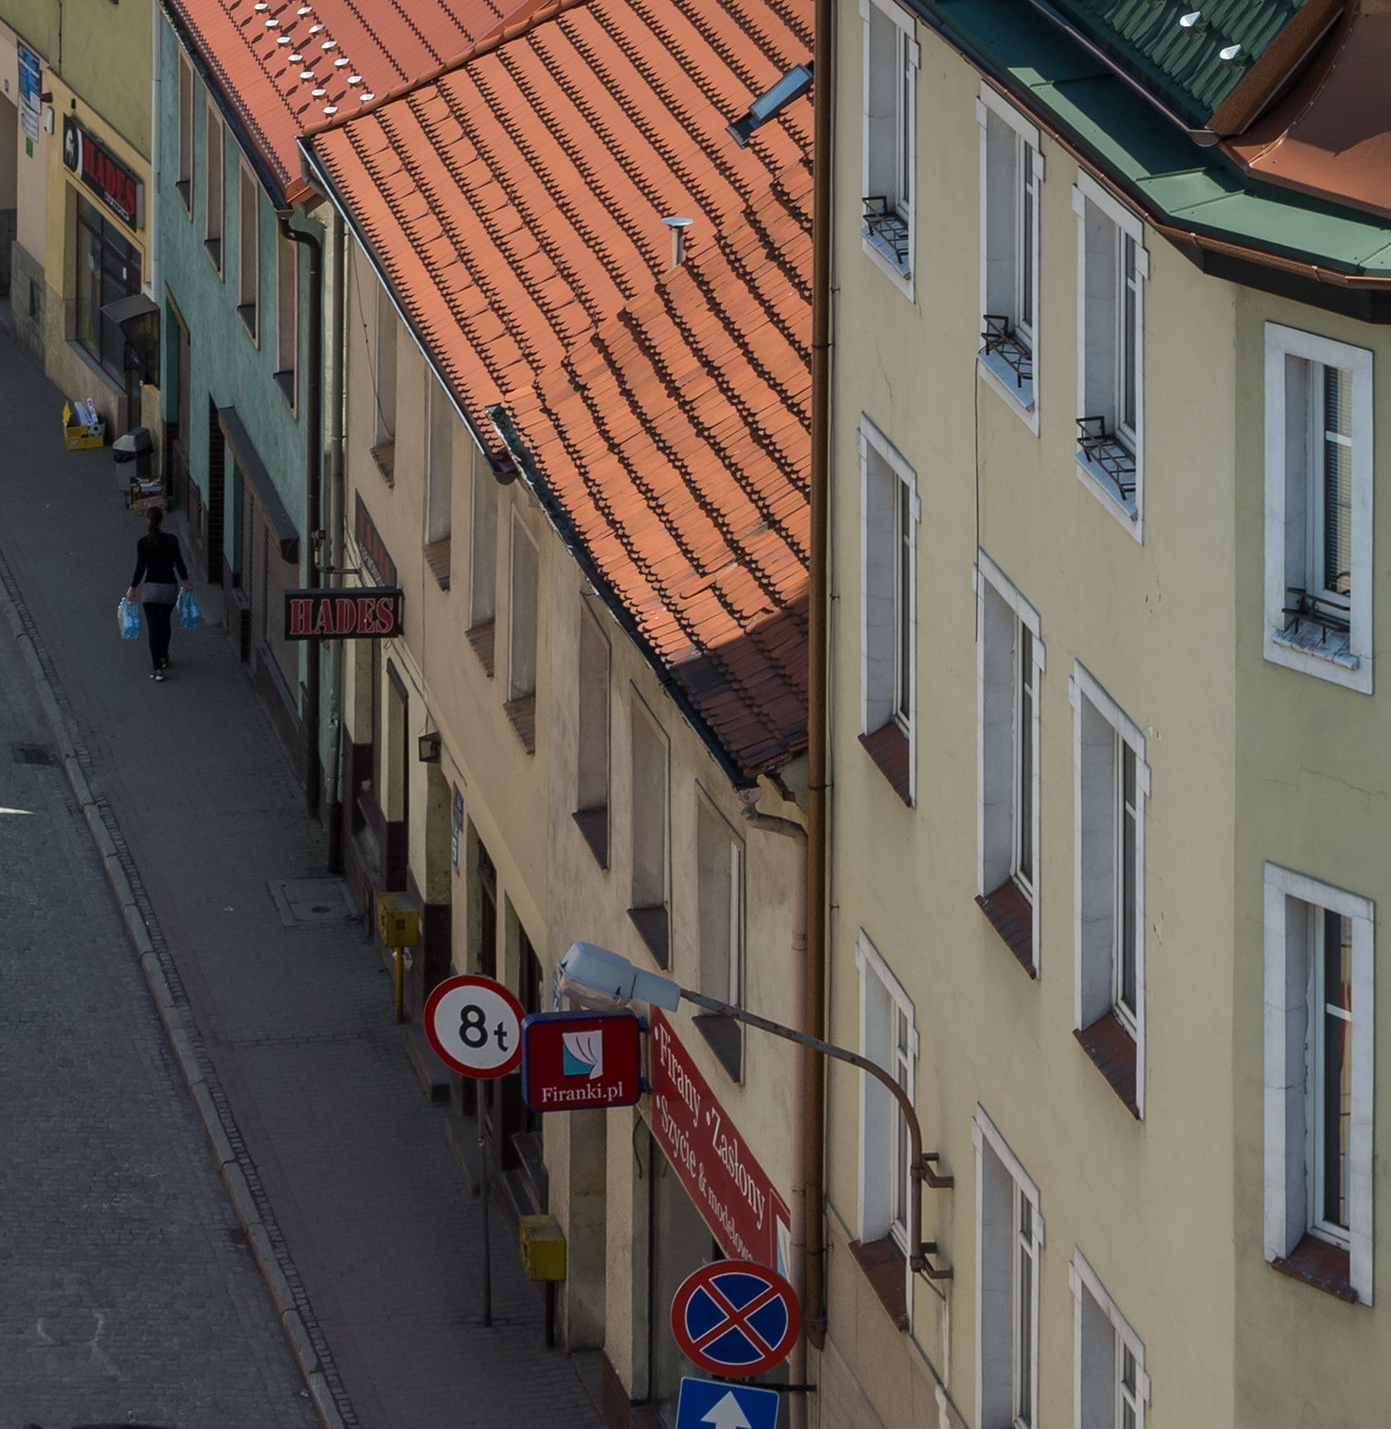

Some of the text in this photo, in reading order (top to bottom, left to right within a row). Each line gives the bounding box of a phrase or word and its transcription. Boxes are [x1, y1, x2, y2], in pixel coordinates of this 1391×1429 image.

[83, 136, 136, 216] HADES
[290, 597, 394, 635] HADES
[541, 1081, 624, 1103] Firanki.pl
[660, 1022, 766, 1231] Firany Zasłony
[661, 1095, 697, 1179] Szycie
[698, 1162, 708, 1199] &
